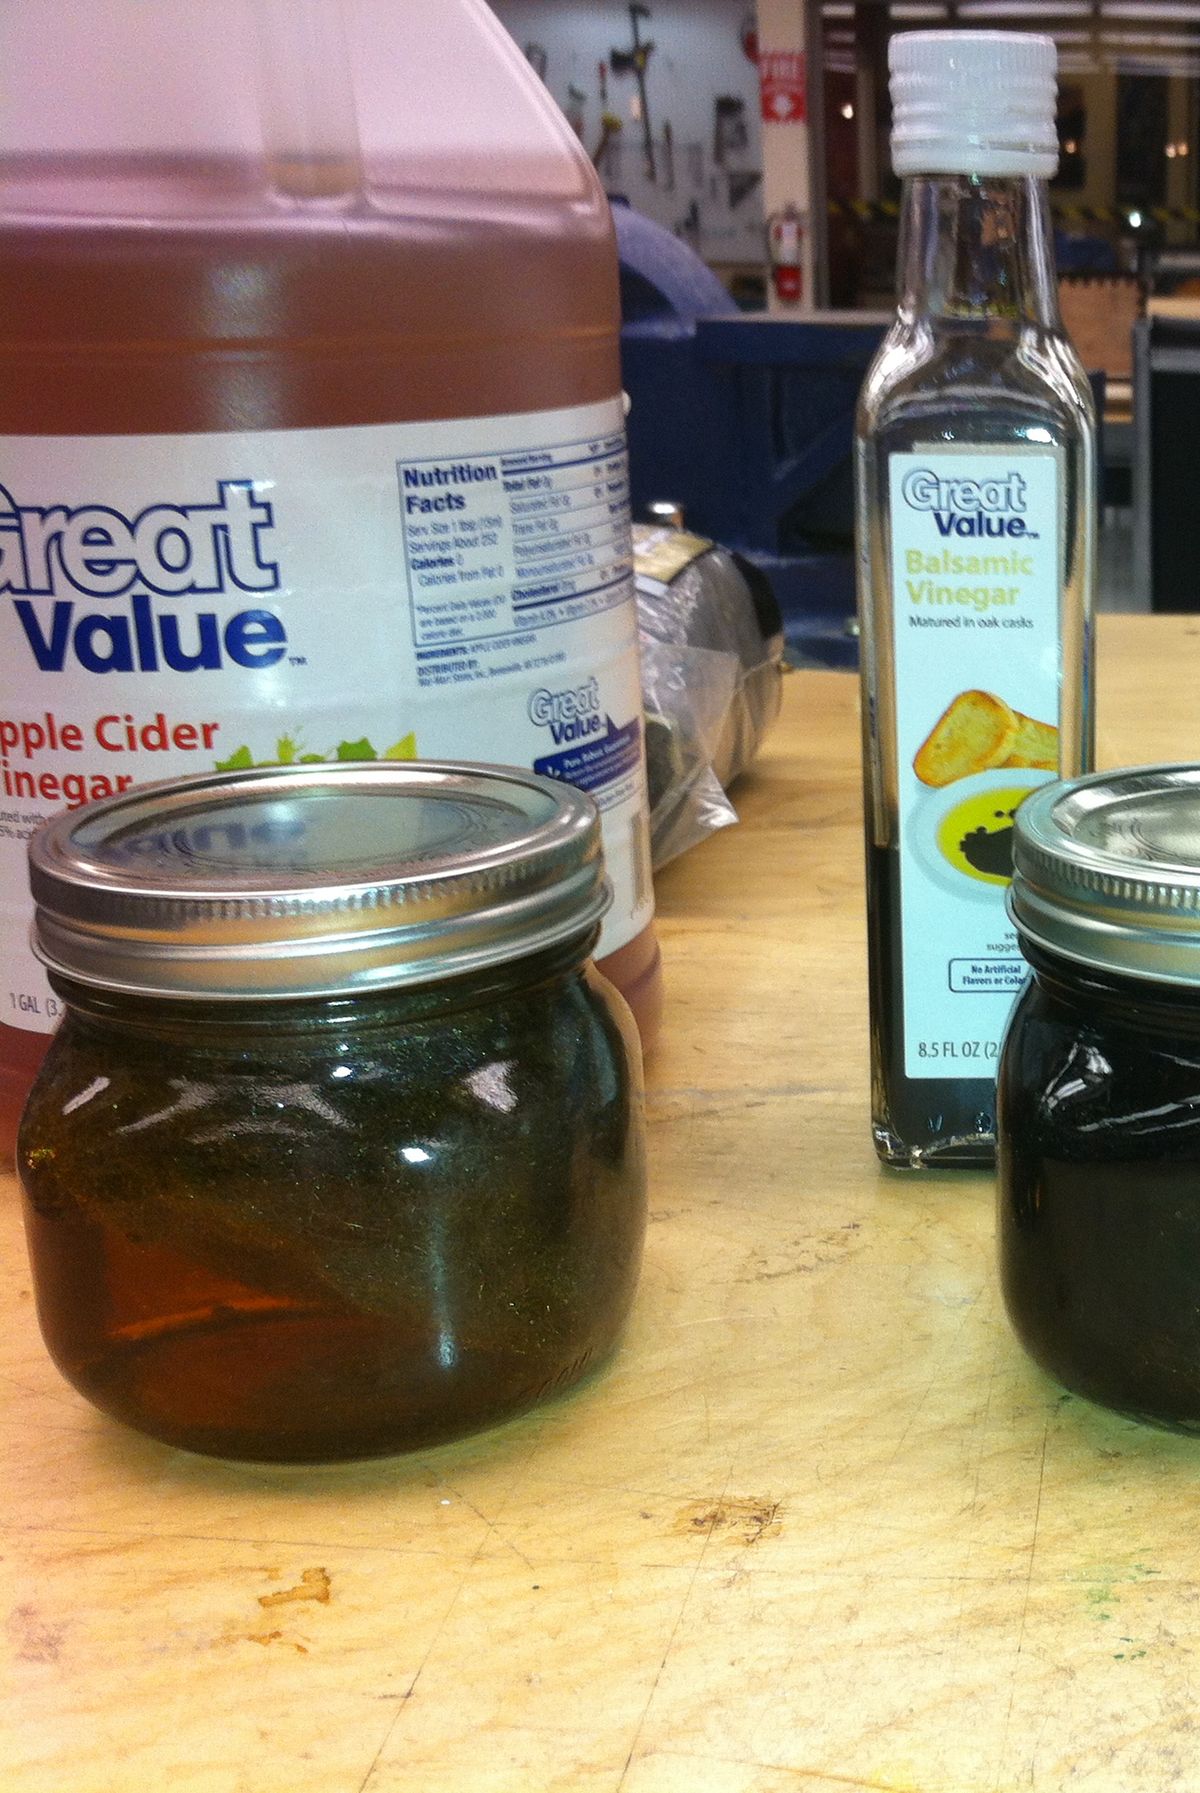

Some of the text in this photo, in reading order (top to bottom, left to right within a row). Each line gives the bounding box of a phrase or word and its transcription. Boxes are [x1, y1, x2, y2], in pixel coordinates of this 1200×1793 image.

[403, 463, 498, 488] Nutrition
[406, 492, 467, 514] Facts
[901, 468, 1027, 513] Great
[0, 479, 280, 597] reat
[934, 511, 1026, 538] Value
[411, 557, 455, 570] Calories
[905, 548, 1034, 575] Balsamic
[905, 580, 1020, 612] Vinegar
[12, 594, 287, 673] Value
[909, 616, 1034, 629] Matured in oak casks
[528, 676, 601, 727] Great
[0, 712, 220, 758] pple Cider
[549, 714, 602, 745] Value
[1, 758, 134, 810] inegar
[962, 976, 991, 985] Flavors
[993, 977, 1003, 985] or
[971, 964, 1021, 974] No Artificial
[9, 992, 16, 1009] 1
[19, 994, 41, 1014] GAL
[918, 1041, 1002, 1060] 8.5 FL OZ (2
